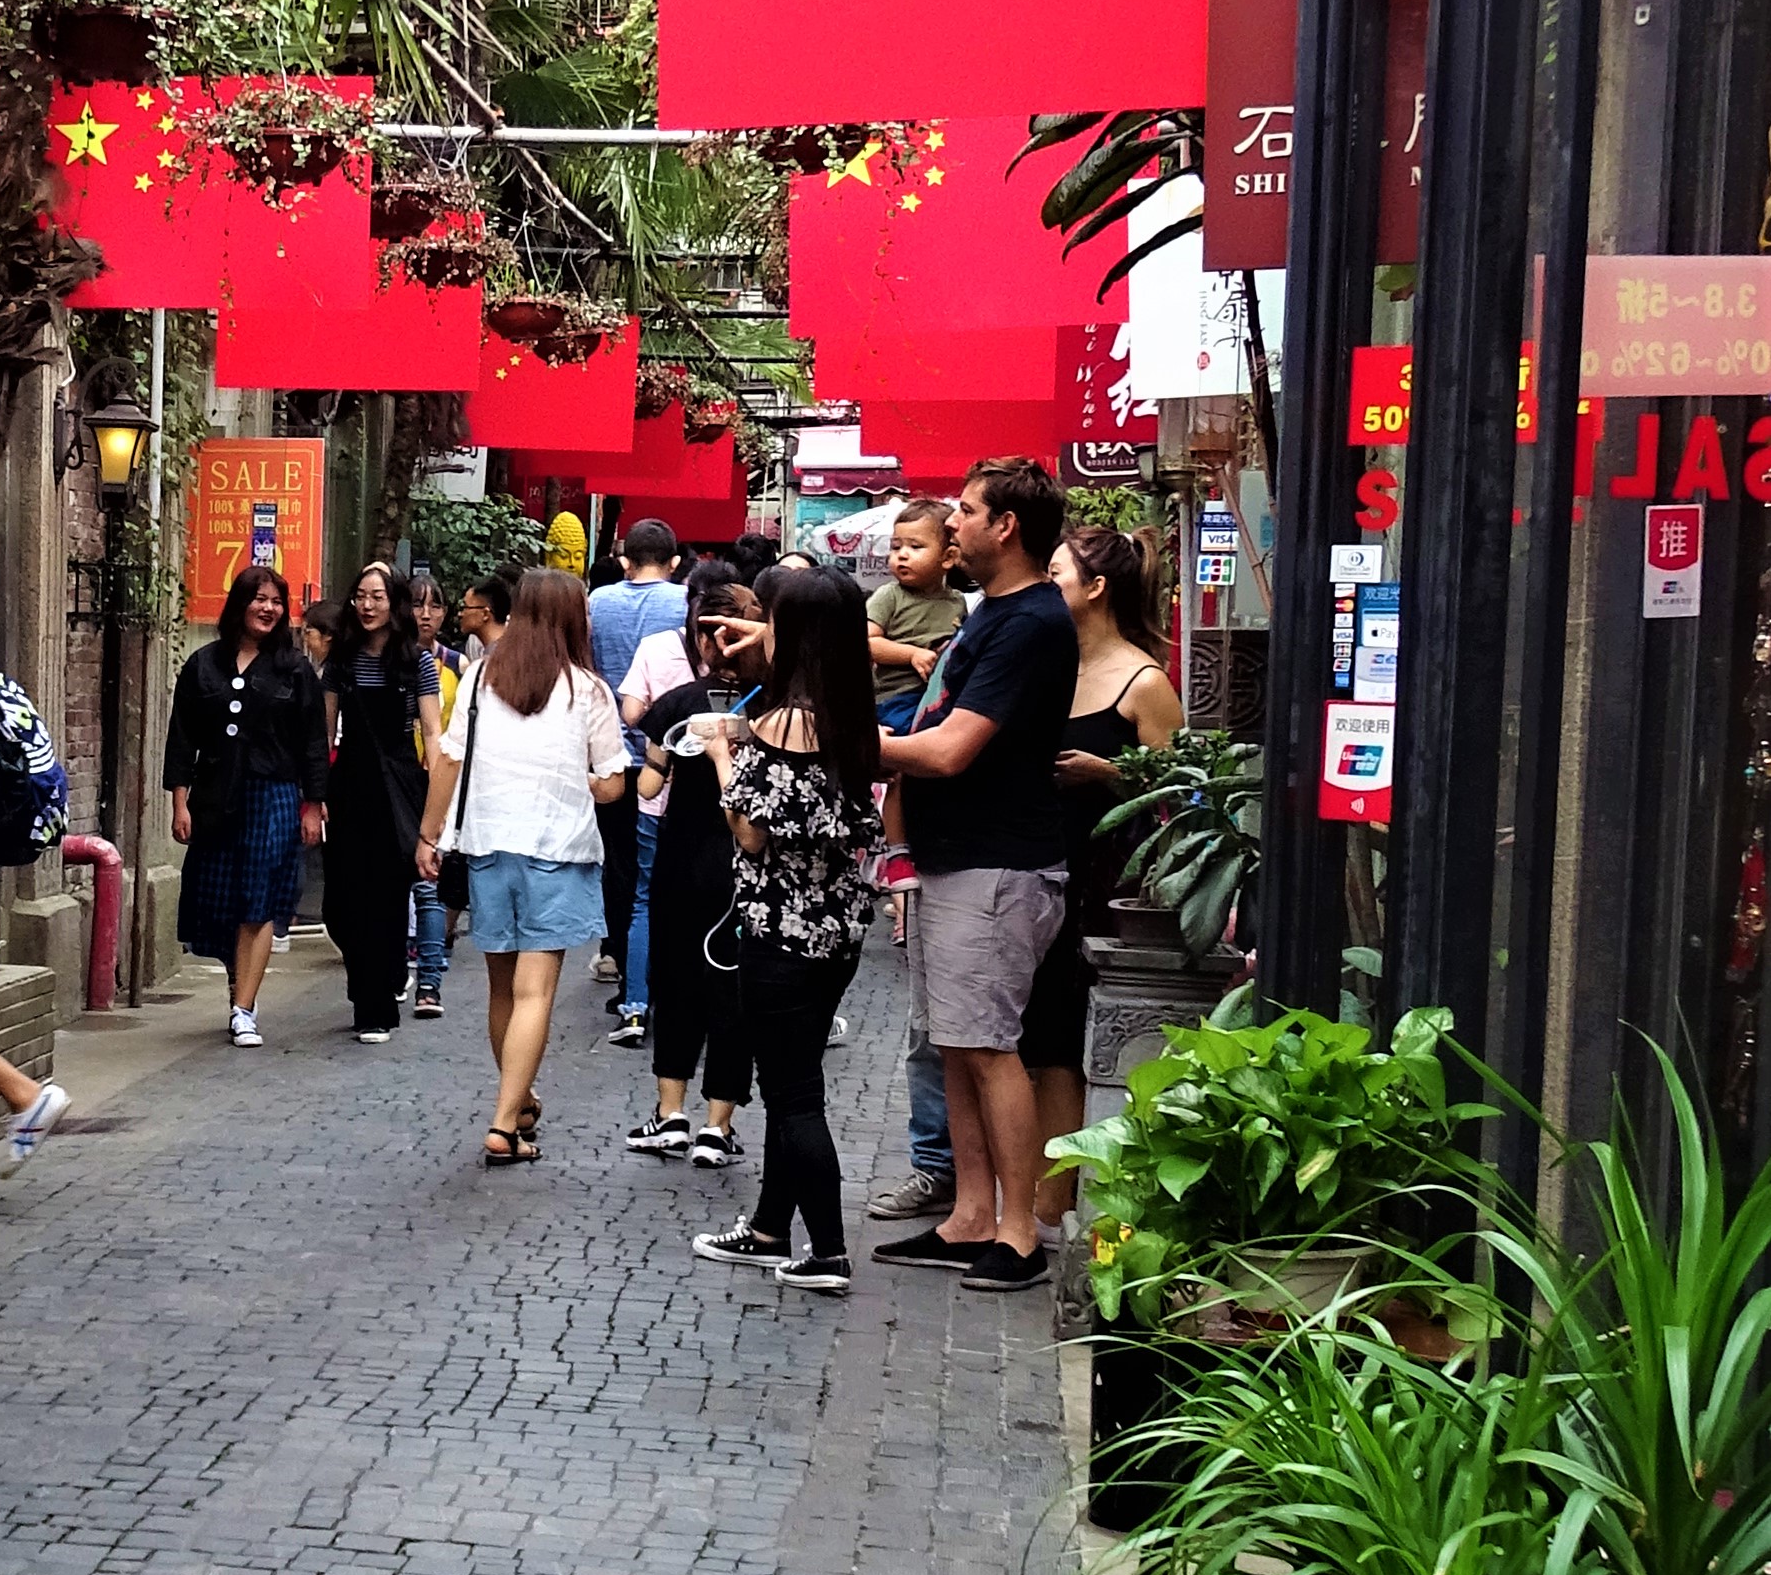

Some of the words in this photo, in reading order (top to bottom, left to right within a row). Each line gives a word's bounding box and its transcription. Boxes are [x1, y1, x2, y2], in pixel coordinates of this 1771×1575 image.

[210, 460, 303, 492] SALE
[1208, 534, 1234, 544] VISA
[1659, 520, 1688, 558] 推
[1335, 718, 1390, 733] 欢迎使用
